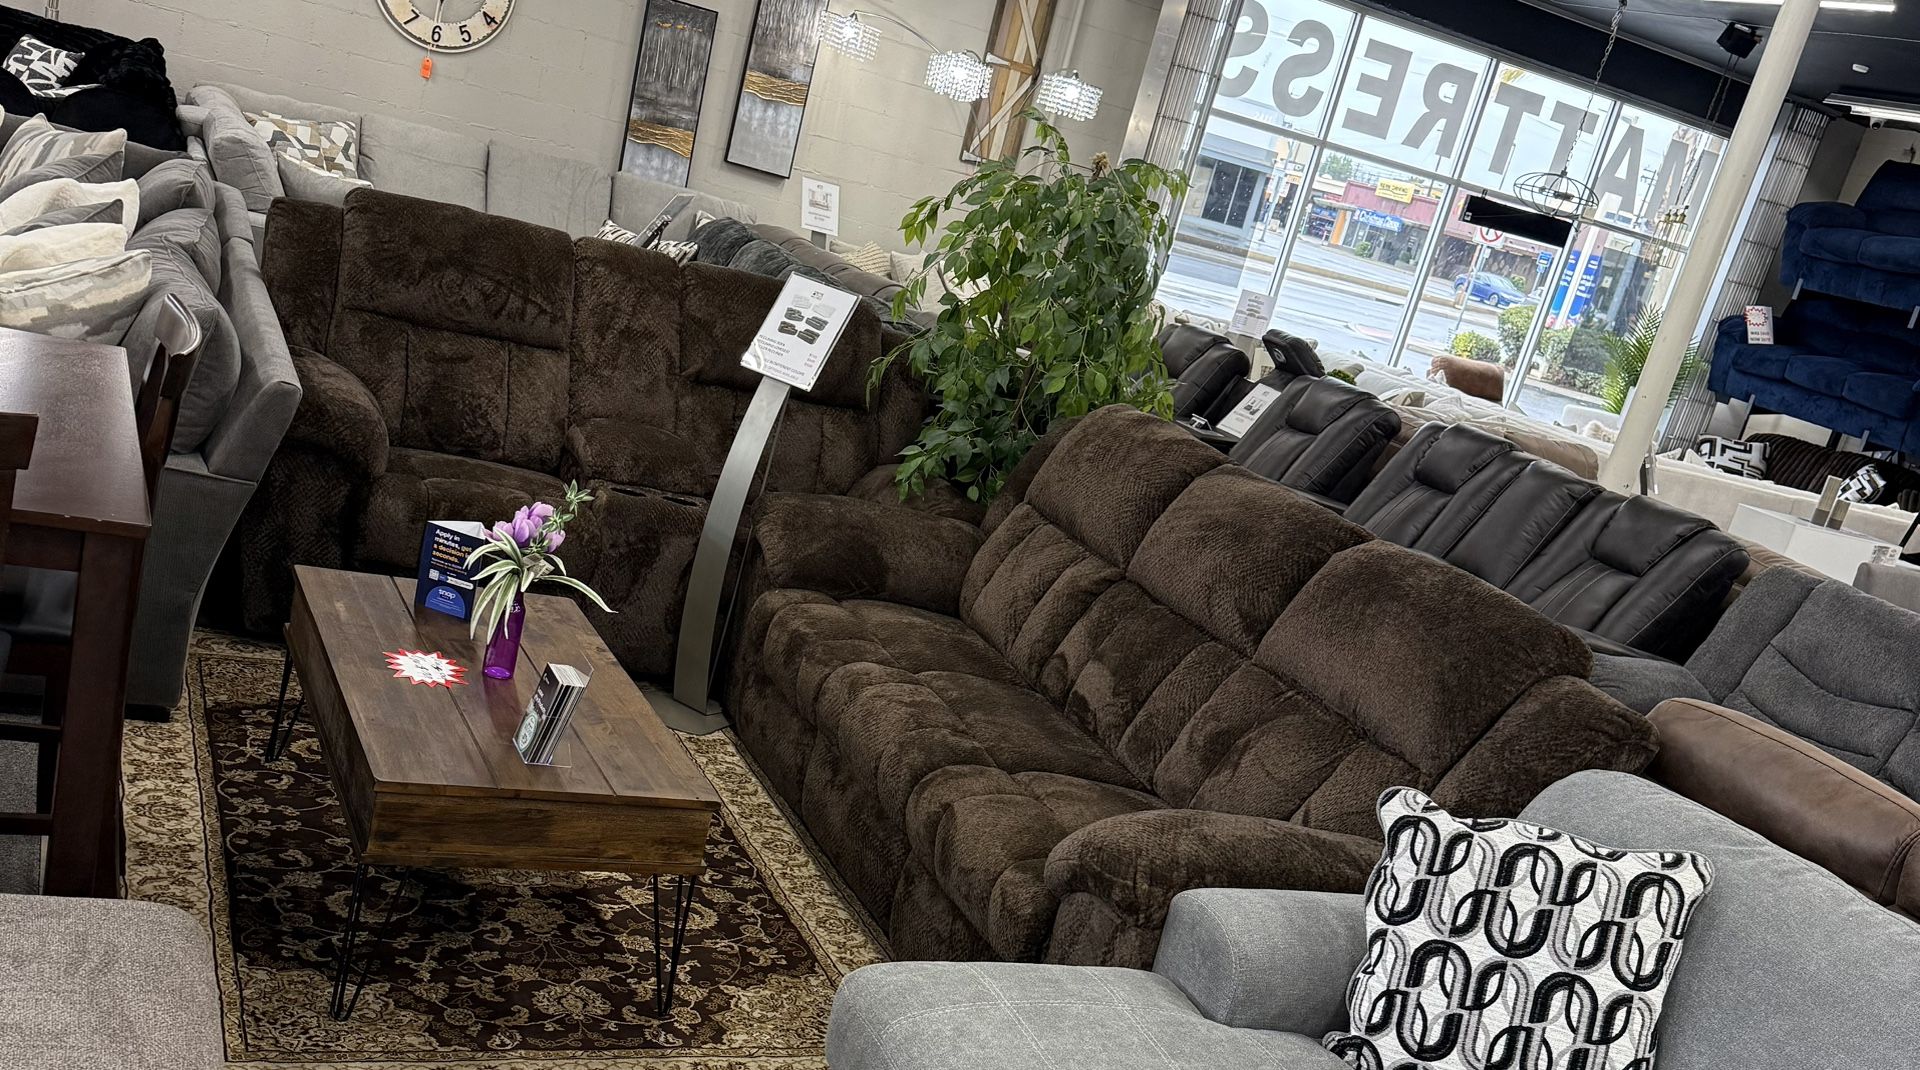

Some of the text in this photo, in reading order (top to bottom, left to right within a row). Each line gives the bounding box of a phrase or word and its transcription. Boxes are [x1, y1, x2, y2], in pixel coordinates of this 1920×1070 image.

[404, 9, 420, 25] 7
[482, 11, 499, 27] 4
[431, 25, 443, 43] 6
[459, 24, 472, 43] 5
[435, 529, 454, 540] Apply
[434, 536, 460, 549] minutes,
[432, 551, 459, 563] seconds.
[438, 545, 464, 556] decision
[438, 589, 456, 599] snap
